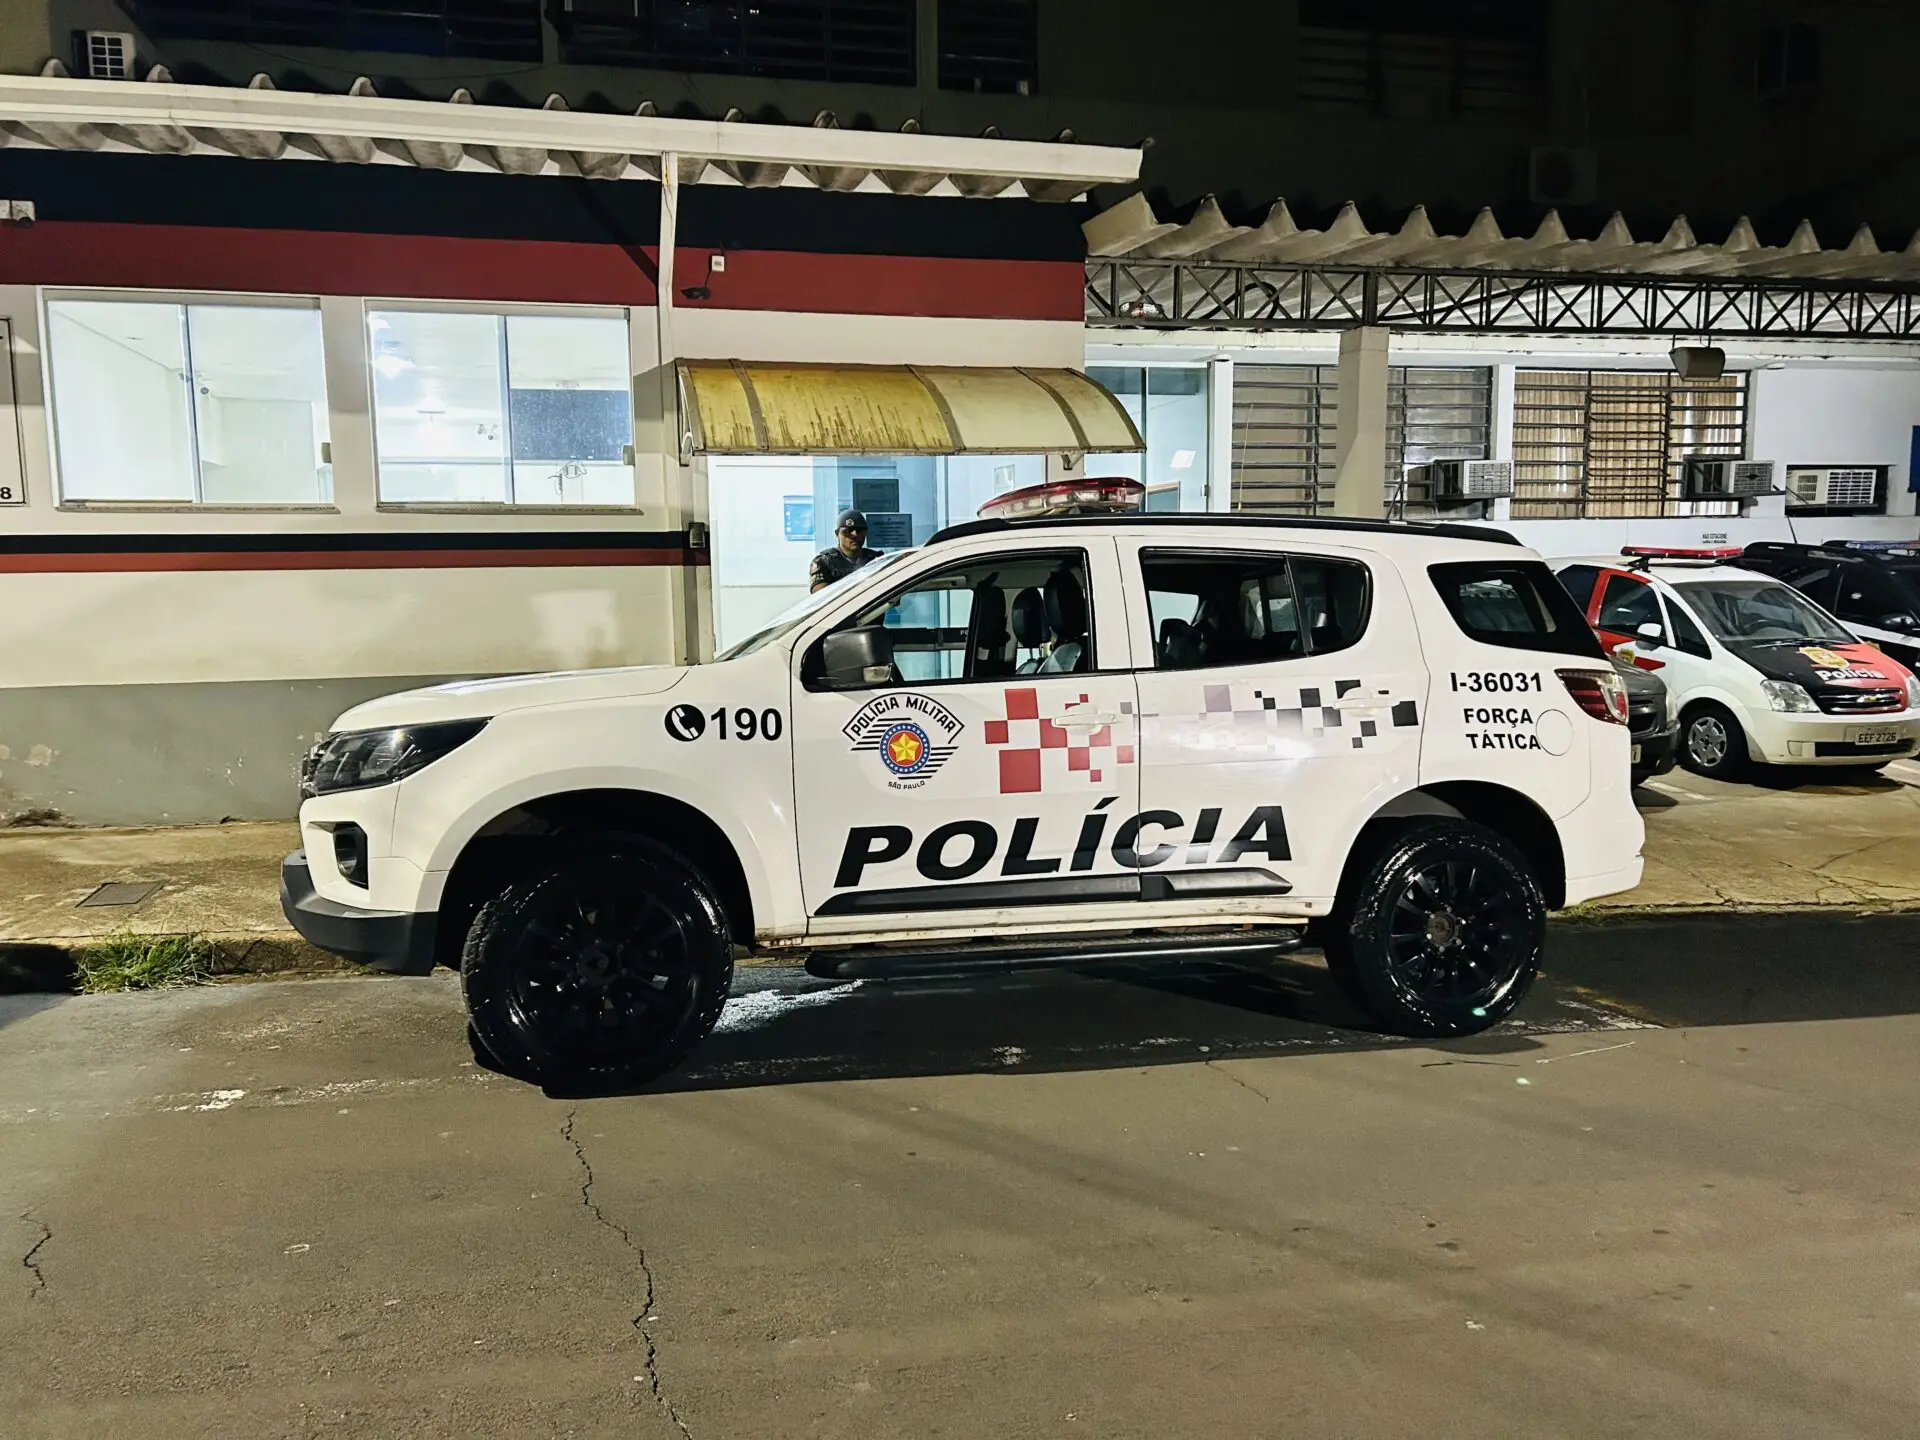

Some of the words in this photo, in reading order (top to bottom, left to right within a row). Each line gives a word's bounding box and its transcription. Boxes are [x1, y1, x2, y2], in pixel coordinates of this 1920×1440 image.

[1450, 672, 1543, 692] I-36031
[711, 707, 782, 741] 190
[851, 697, 899, 736] POLÍCIA
[906, 696, 956, 734] MILITAR
[1464, 708, 1533, 728] FORÇA
[1466, 729, 1541, 750] TÁTICA
[888, 781, 901, 790] SÃO
[903, 780, 925, 790] PAULO
[833, 796, 1293, 888] POLÍCIA
